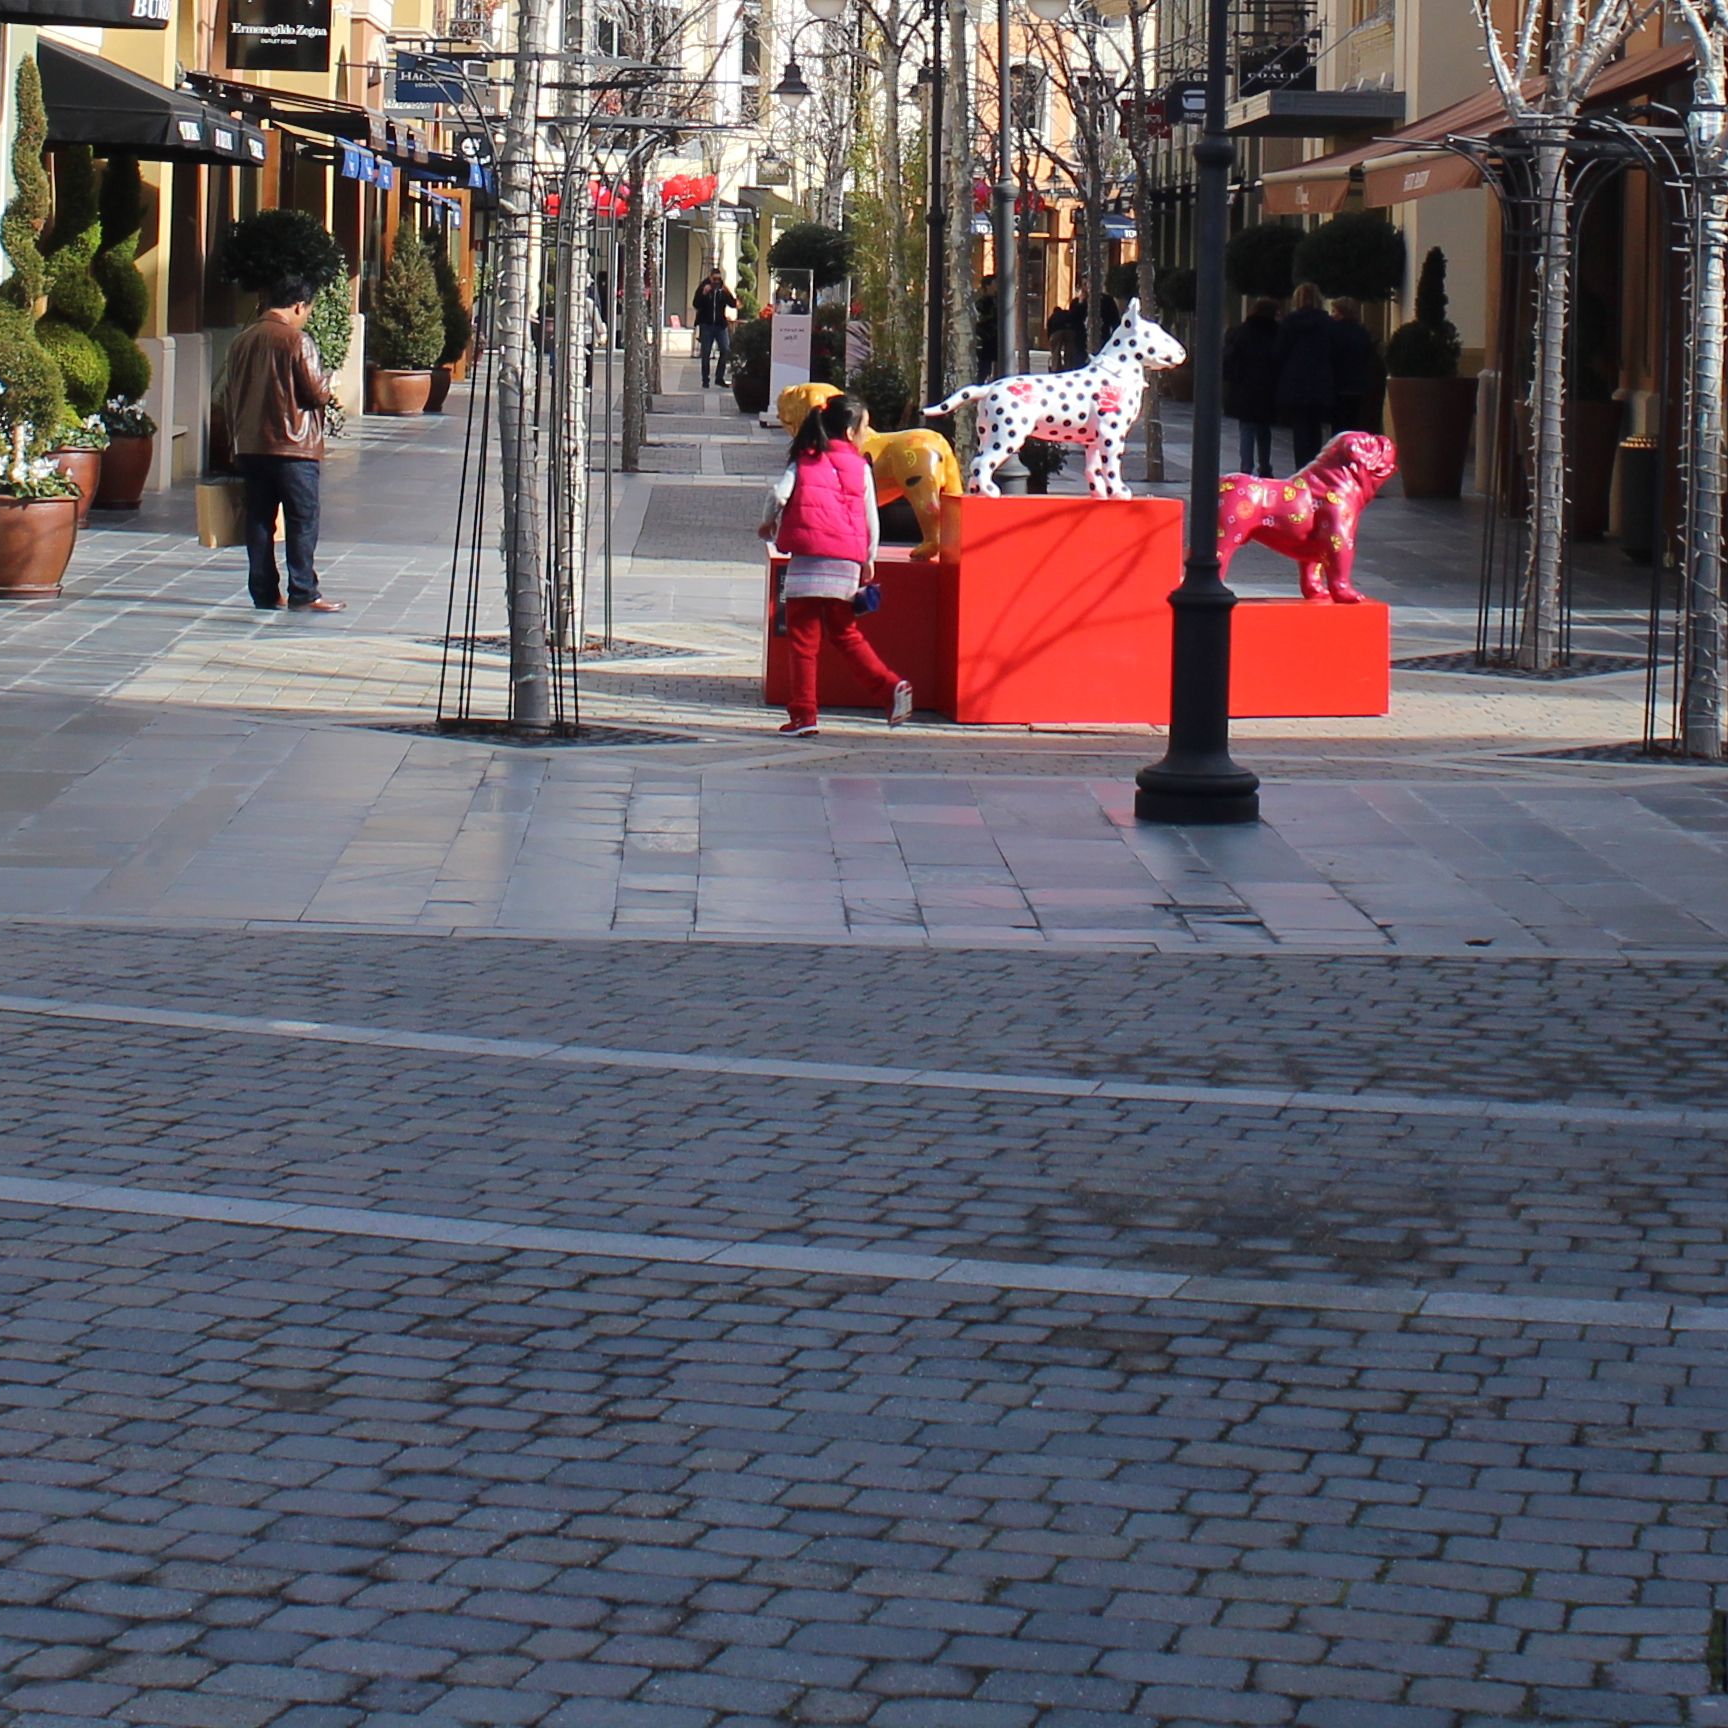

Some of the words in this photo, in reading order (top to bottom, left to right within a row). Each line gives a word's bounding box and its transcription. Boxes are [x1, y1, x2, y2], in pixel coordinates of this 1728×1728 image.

[230, 22, 296, 38] Ermenegildo
[296, 24, 328, 39] Zegna
[1247, 72, 1300, 80] COACH
